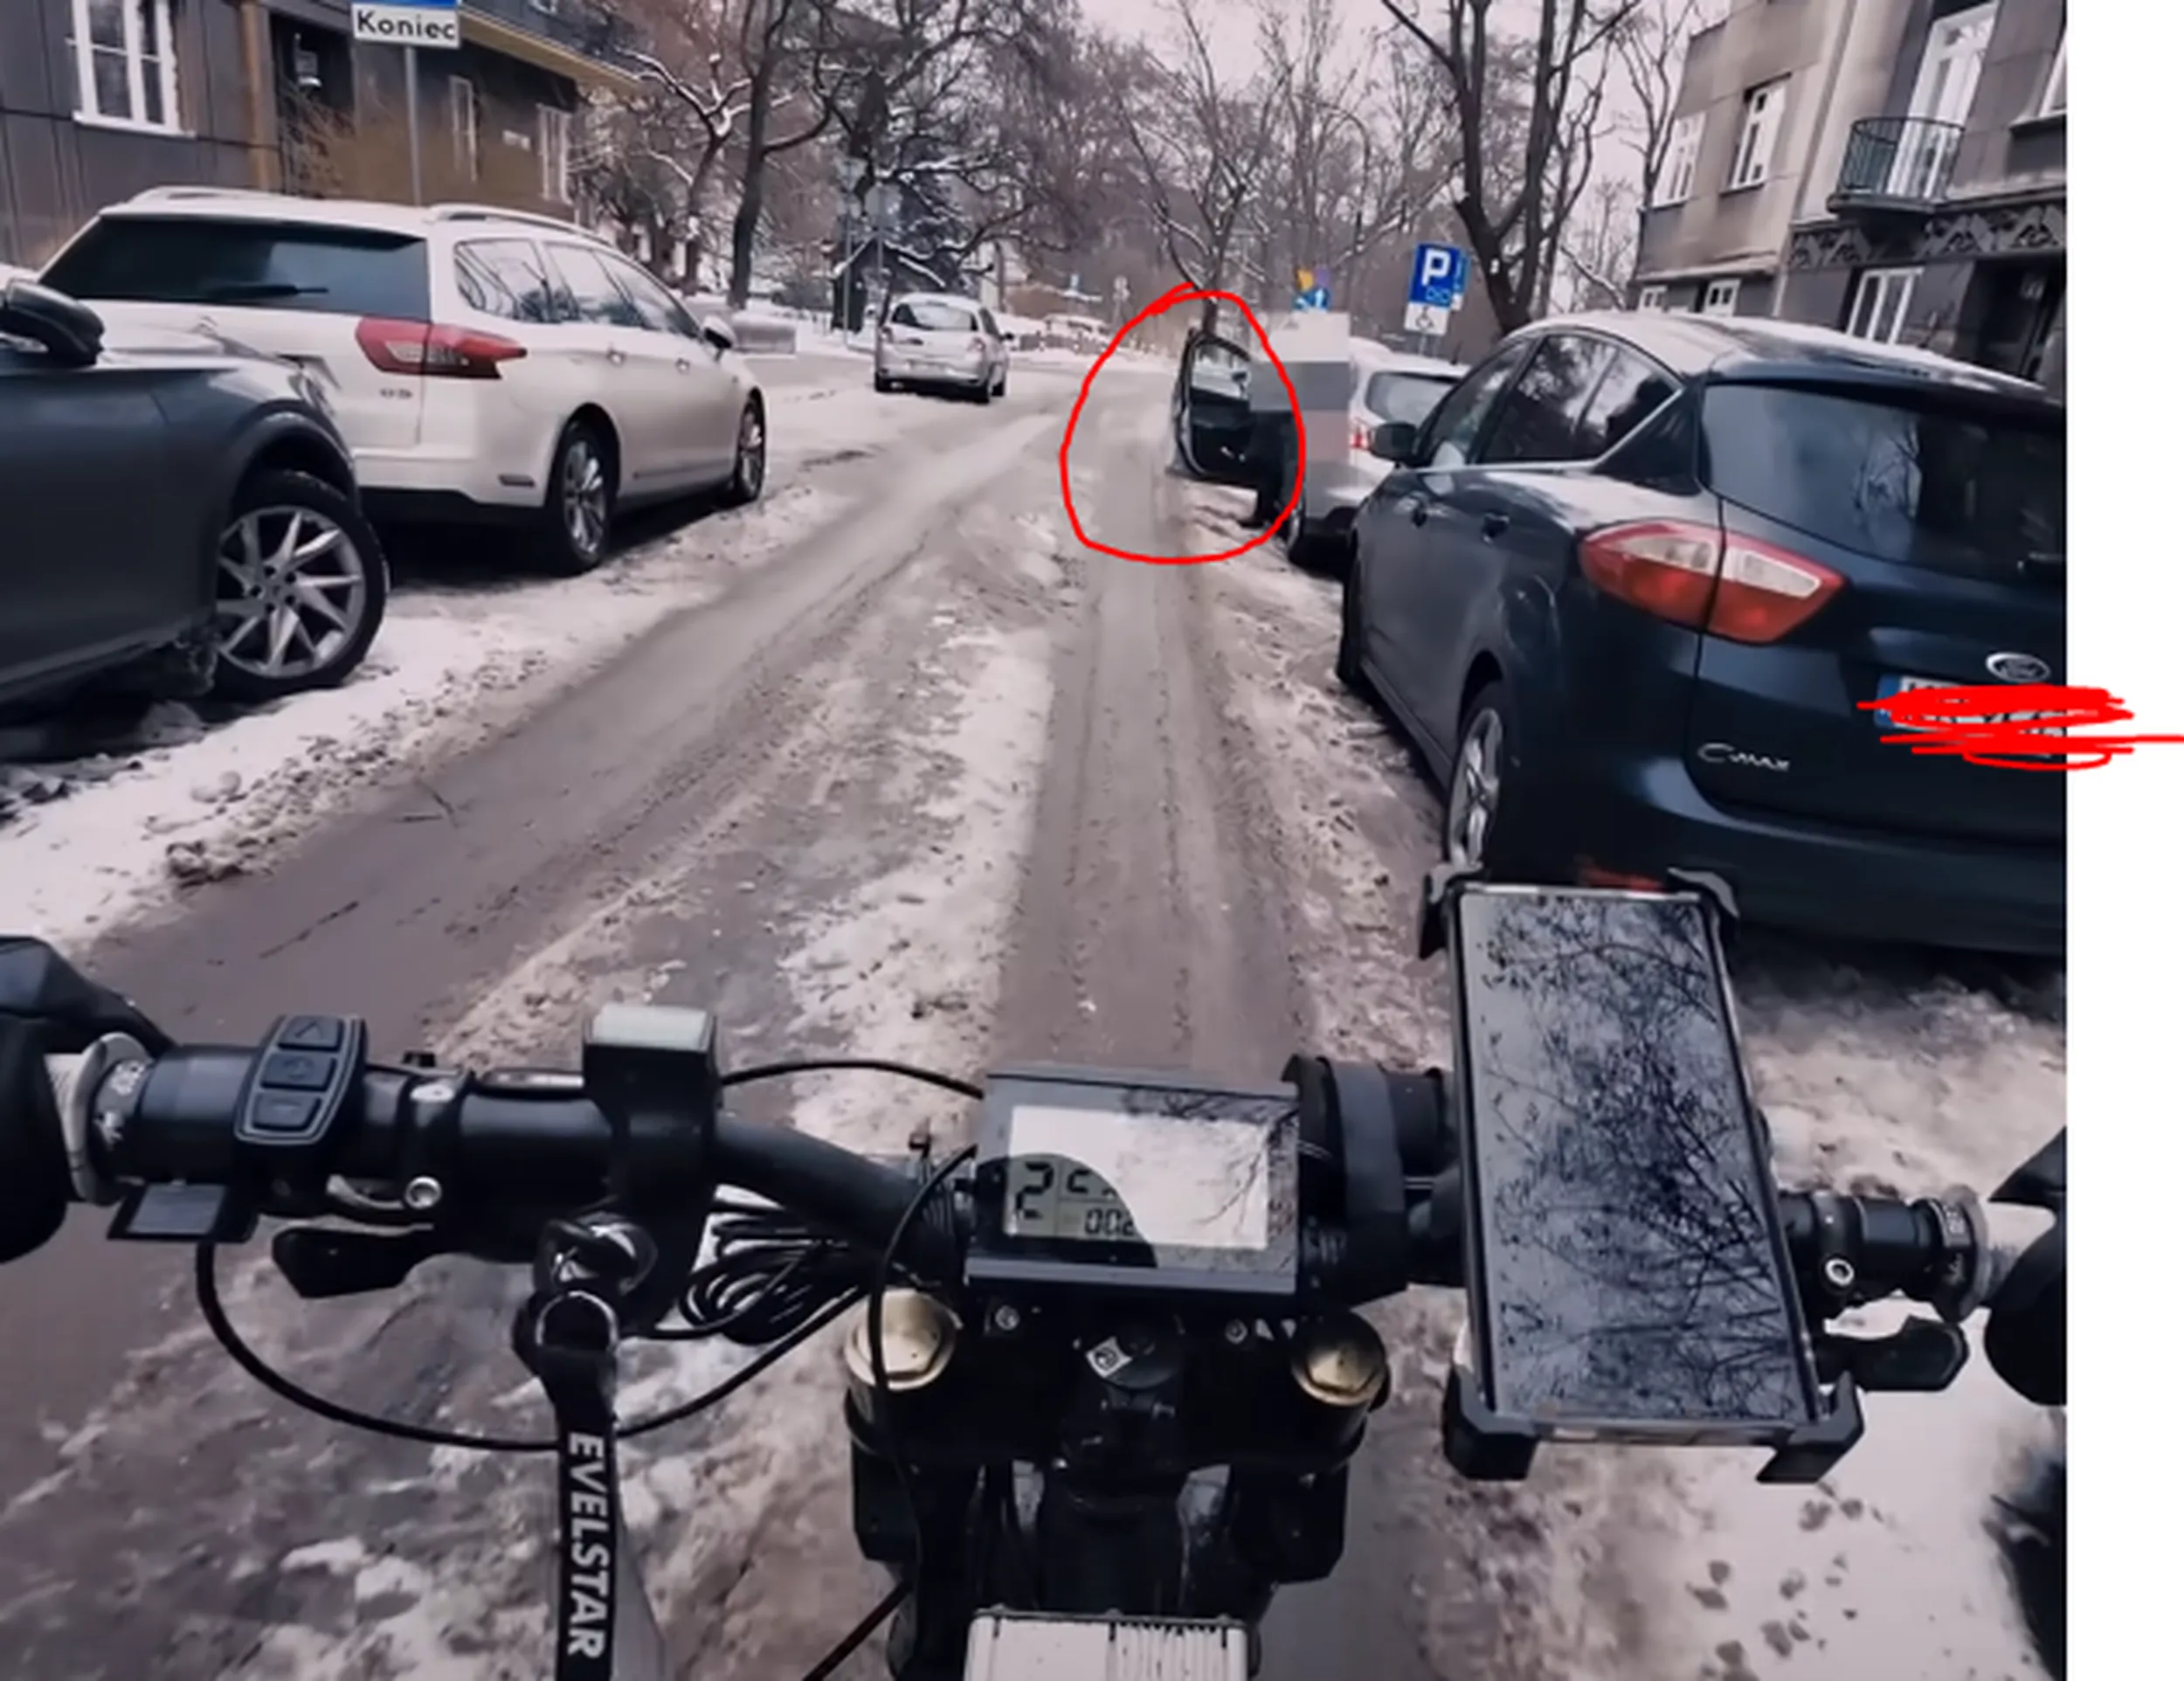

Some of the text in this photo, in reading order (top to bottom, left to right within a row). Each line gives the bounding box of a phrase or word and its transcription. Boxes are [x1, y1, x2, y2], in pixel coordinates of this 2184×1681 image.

[358, 10, 455, 39] Koniec
[1422, 249, 1450, 287] P
[568, 1431, 610, 1659] EVELSTAR
